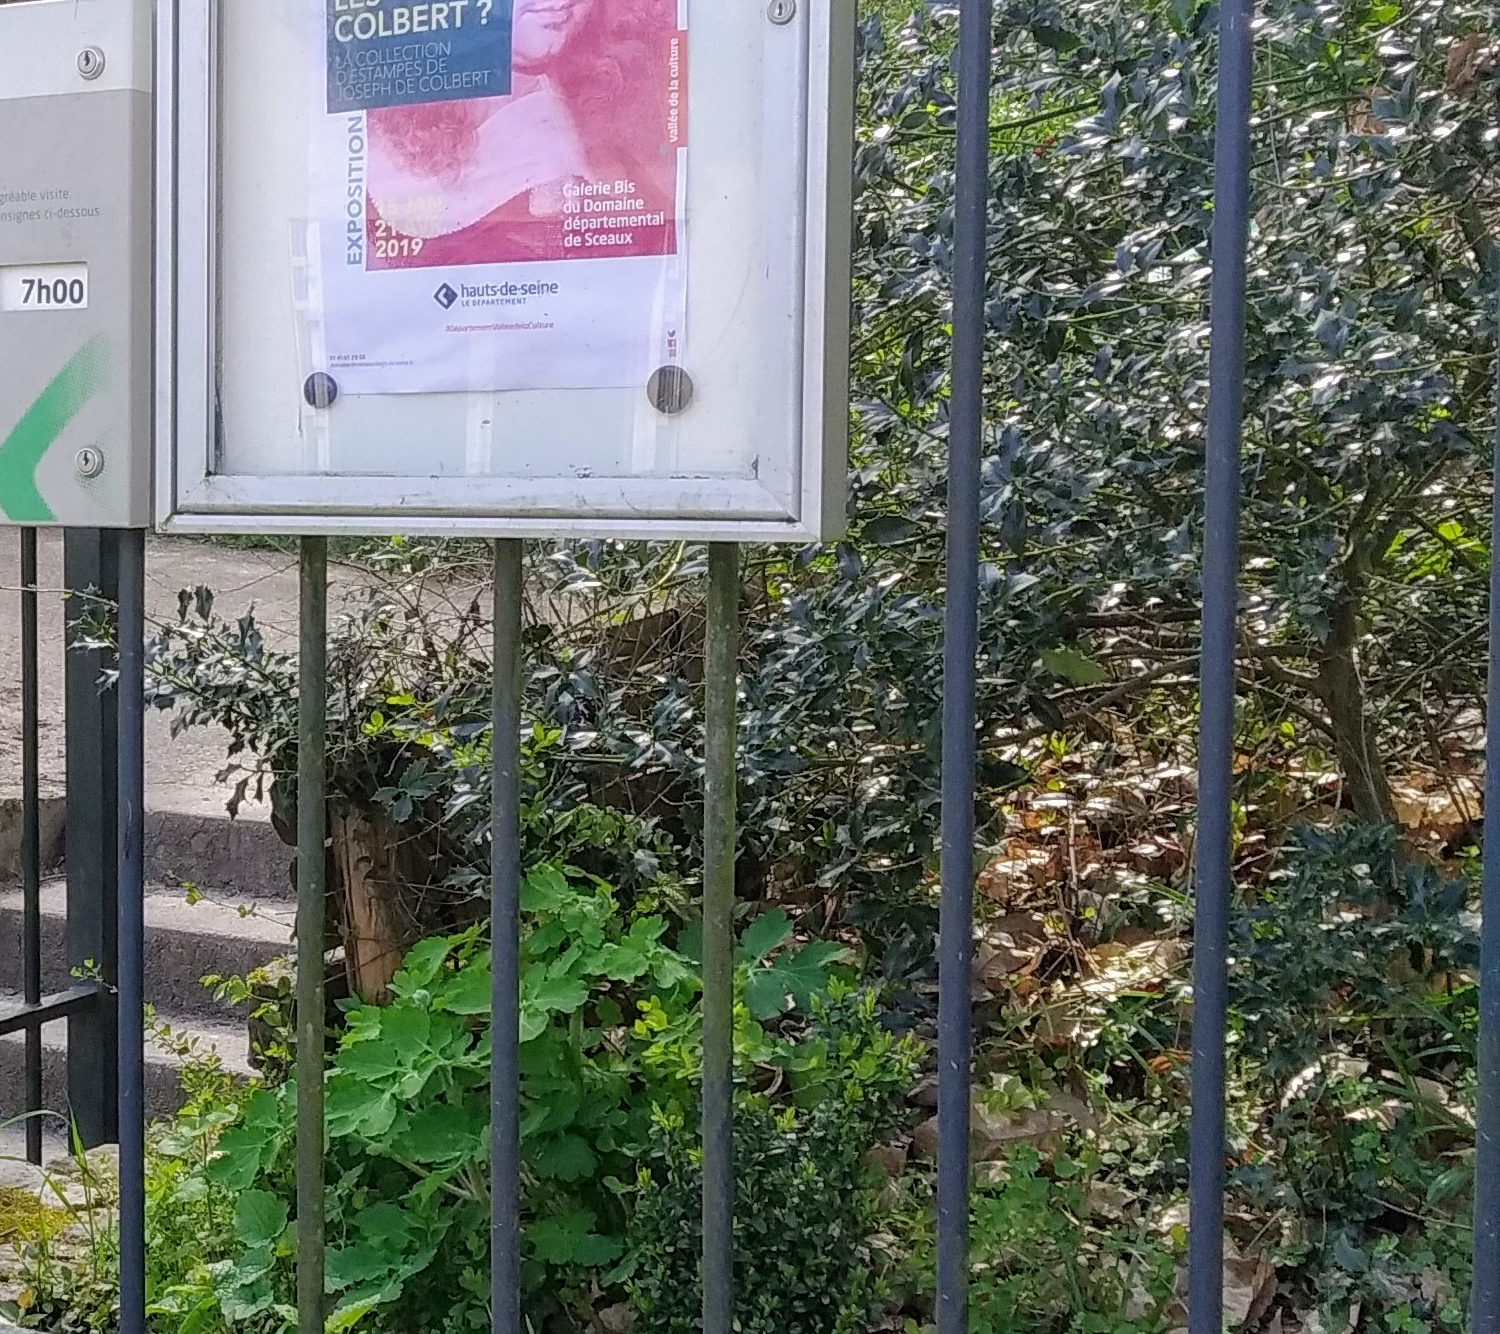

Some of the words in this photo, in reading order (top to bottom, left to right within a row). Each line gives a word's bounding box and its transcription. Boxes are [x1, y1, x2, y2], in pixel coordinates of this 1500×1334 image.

[334, 0, 469, 43] COLBERT
[336, 50, 352, 69] LA
[355, 42, 451, 67] COLLECTION
[668, 38, 679, 78] culture
[427, 58, 447, 75] DE
[335, 82, 391, 102] JOSEPH
[396, 78, 416, 95] DE
[419, 70, 491, 92] COLBERT
[668, 79, 679, 91] la
[667, 108, 678, 143] vallée
[347, 116, 364, 266] EXPOSITION
[563, 181, 611, 197] Galerie
[614, 179, 636, 194] Bis
[563, 200, 580, 214] du
[584, 197, 644, 213] Domaine
[374, 219, 397, 237] 21
[564, 212, 665, 233] départemental
[376, 238, 423, 258] 2019
[564, 234, 582, 247] de
[585, 231, 633, 247] Sceaux
[22, 278, 84, 304] 7h00
[460, 279, 559, 298] hauts-de-seine
